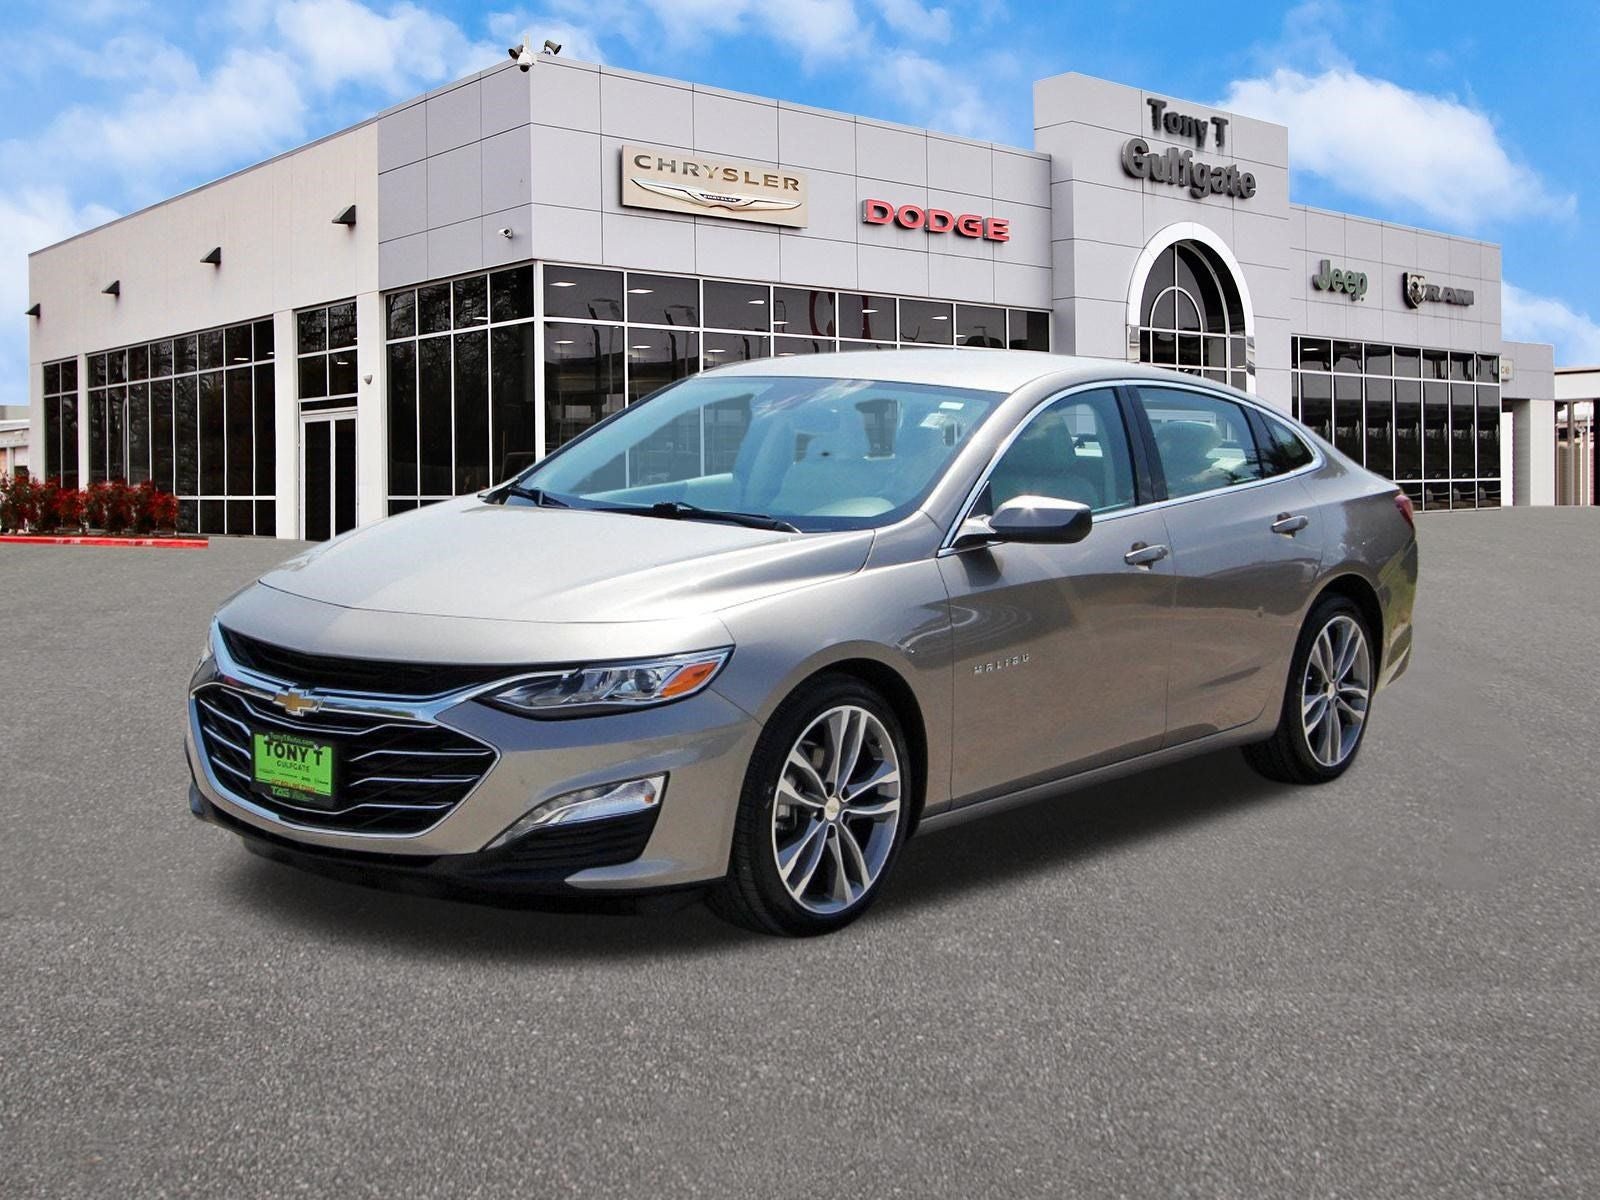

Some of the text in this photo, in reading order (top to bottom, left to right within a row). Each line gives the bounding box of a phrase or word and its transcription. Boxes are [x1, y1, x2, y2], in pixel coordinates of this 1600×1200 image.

[1146, 98, 1229, 148] Tony T
[634, 154, 800, 191] CHRYSLER
[1121, 138, 1256, 199] Gulfgate
[862, 199, 1010, 243] DODGE
[1312, 259, 1368, 302] Jeep
[1425, 283, 1474, 306] RAM
[264, 740, 323, 766] TONY T
